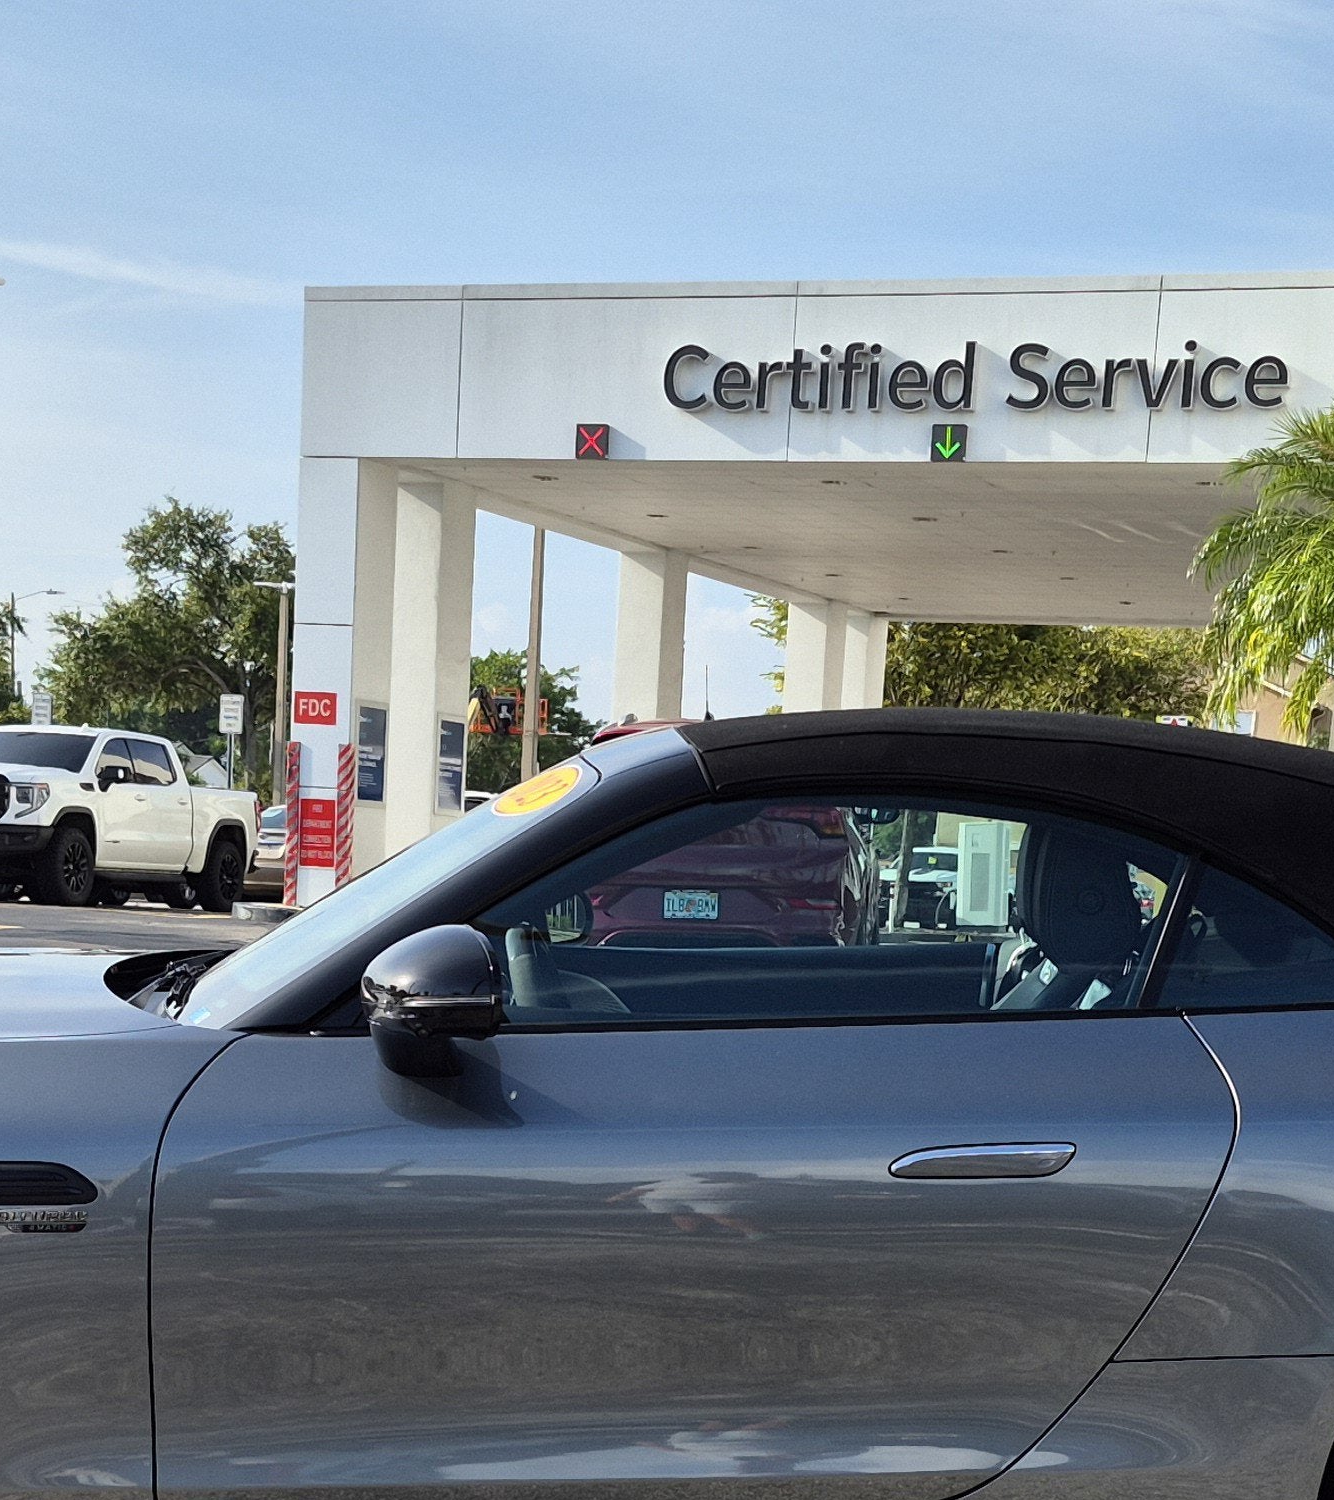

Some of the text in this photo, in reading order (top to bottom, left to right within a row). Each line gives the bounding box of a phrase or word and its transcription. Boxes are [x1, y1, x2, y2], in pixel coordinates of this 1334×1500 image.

[664, 339, 1292, 413] Certified Service
[299, 698, 332, 717] FDC
